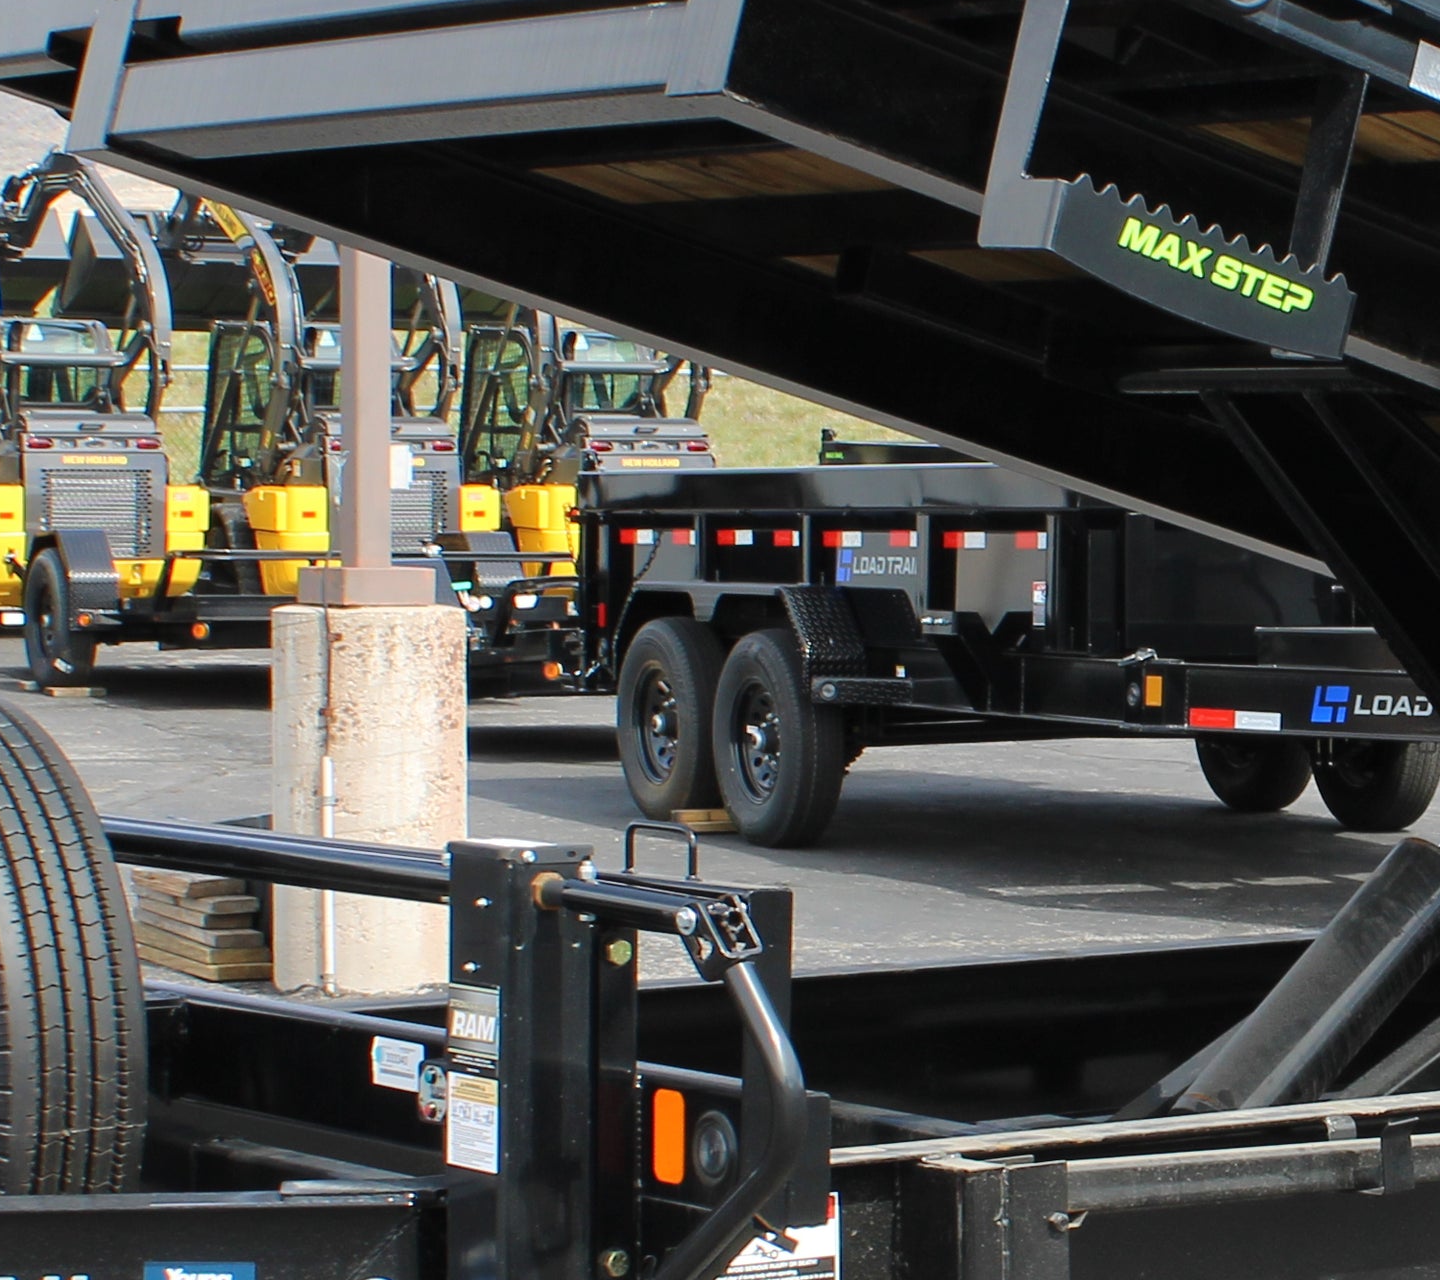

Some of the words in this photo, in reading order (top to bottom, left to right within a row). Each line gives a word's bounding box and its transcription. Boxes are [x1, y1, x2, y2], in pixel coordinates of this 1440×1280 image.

[1117, 216, 1214, 278] MAX
[1210, 253, 1315, 314] STEP
[853, 556, 886, 575] LOAD
[1353, 694, 1433, 717] LOAD
[452, 1009, 496, 1042] RAM
